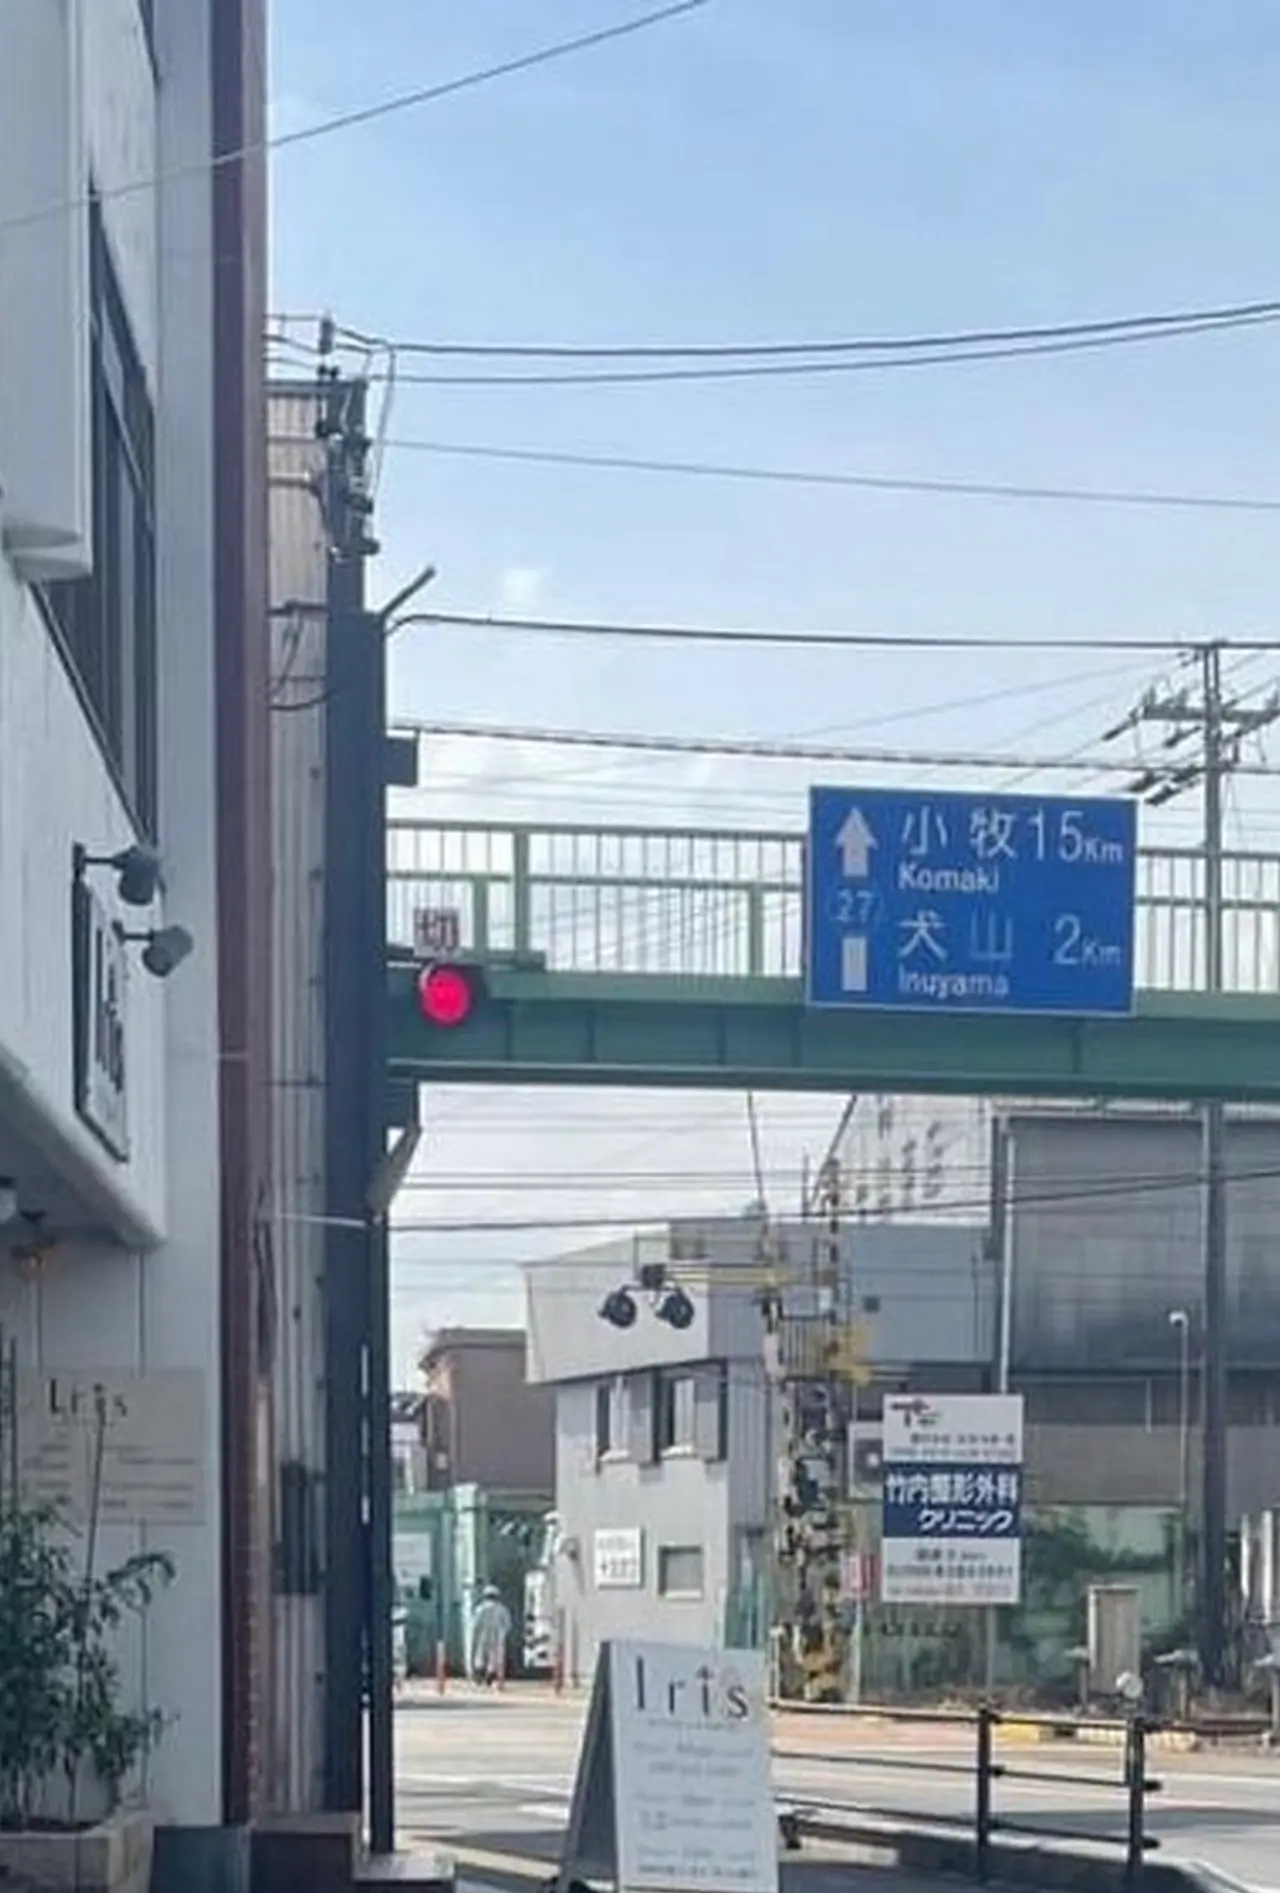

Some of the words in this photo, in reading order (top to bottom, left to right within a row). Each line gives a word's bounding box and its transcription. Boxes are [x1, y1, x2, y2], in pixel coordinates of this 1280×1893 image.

[899, 805, 1019, 861] 小牧
[897, 861, 1000, 893] Komaki
[896, 909, 1014, 962] 犬山
[897, 964, 1011, 1000] Inuyama
[918, 1509, 1014, 1533] クリニック
[635, 1654, 750, 1720] Iris
